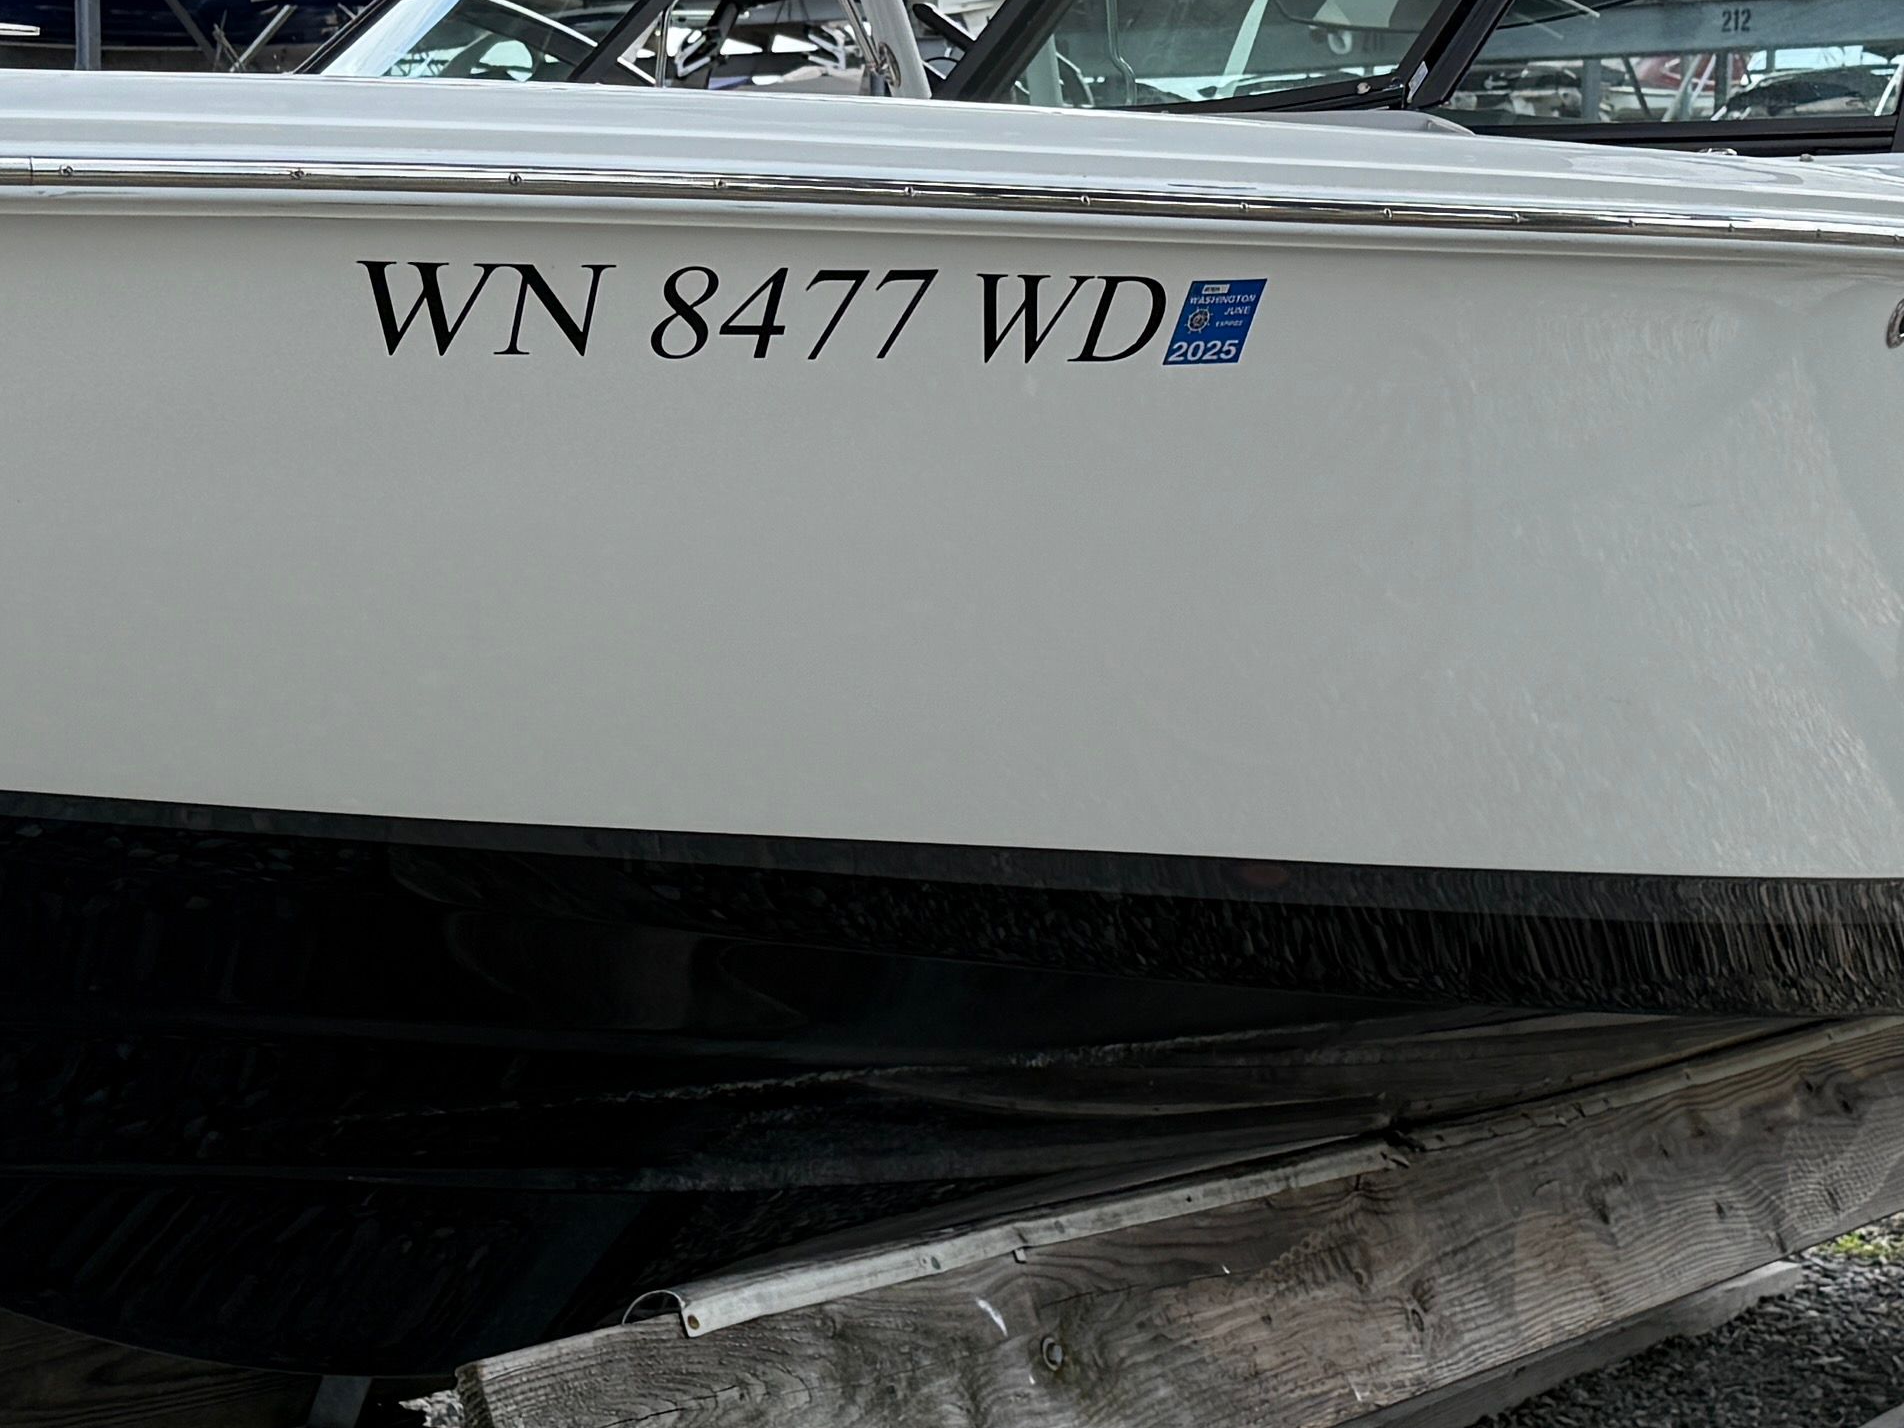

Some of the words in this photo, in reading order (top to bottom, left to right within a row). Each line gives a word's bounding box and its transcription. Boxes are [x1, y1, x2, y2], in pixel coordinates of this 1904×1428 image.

[1720, 7, 1752, 34] 212
[1189, 294, 1256, 305] WASHINGTON
[1224, 306, 1251, 315] JUNE
[356, 260, 617, 357] WN
[650, 265, 939, 360] 8477
[976, 273, 1168, 365] WD
[1167, 340, 1239, 362] 2025
